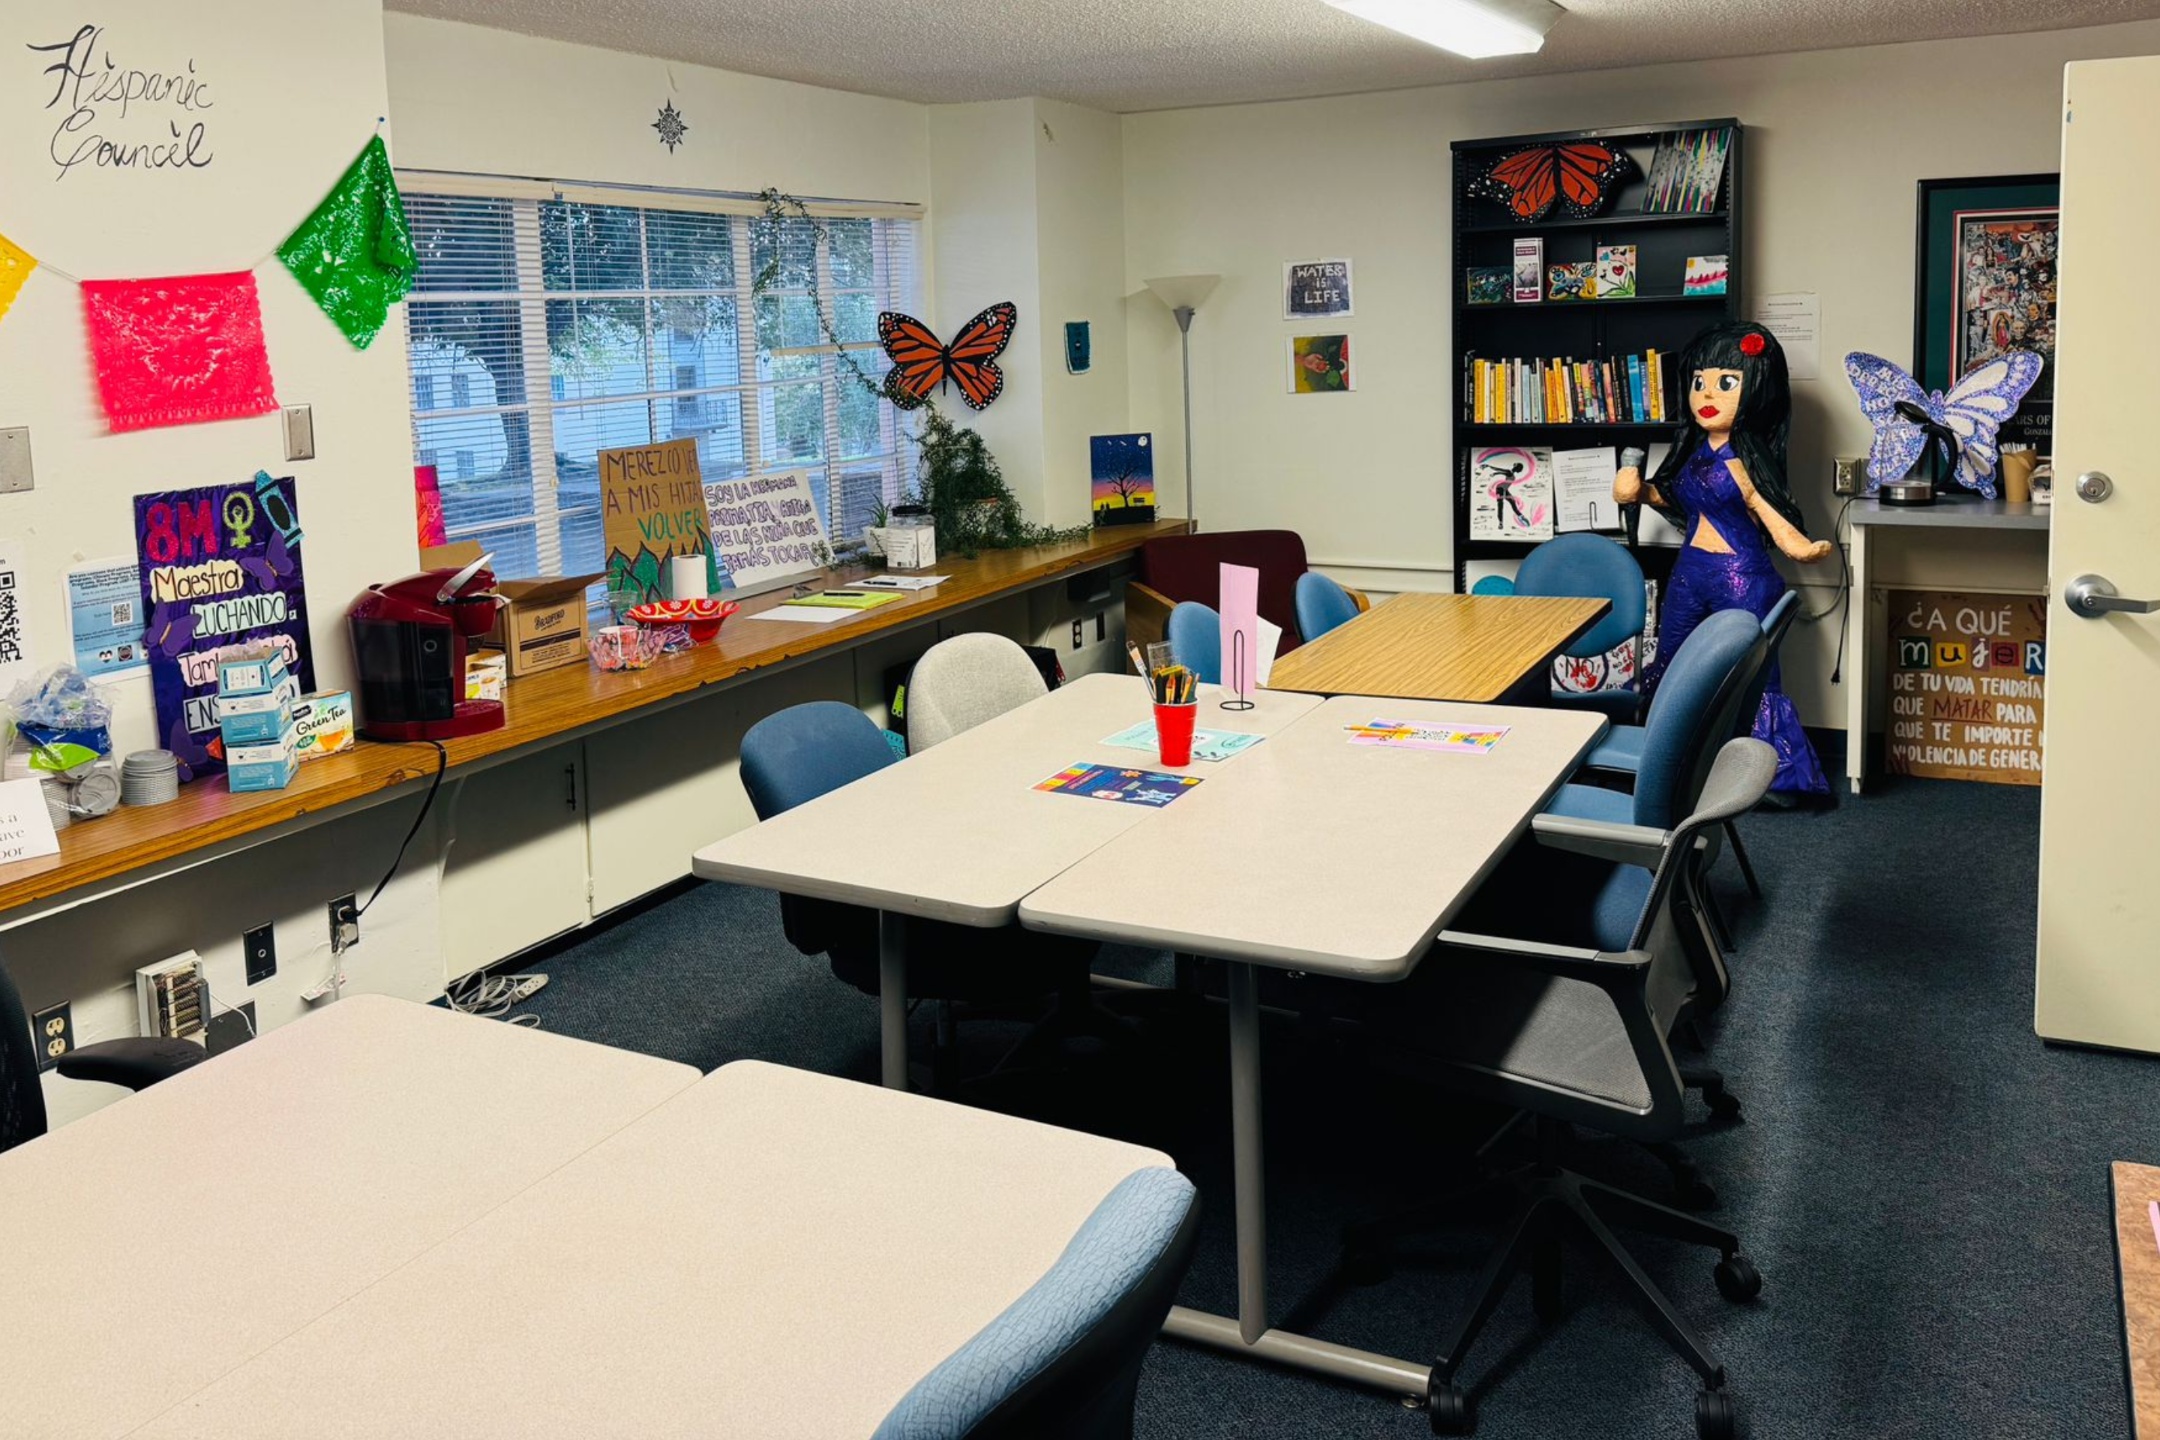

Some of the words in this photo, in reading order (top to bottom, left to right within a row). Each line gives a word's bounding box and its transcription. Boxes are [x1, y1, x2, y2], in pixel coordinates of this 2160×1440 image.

[26, 24, 214, 118] Hispanic
[50, 105, 214, 182] Council
[1295, 264, 1343, 278] WATER
[1304, 289, 1340, 304] LIFE
[2036, 414, 2052, 426] OF
[606, 446, 681, 483] MEREZCO
[607, 488, 622, 518] A
[627, 482, 660, 514] MIS
[704, 484, 735, 507] SOY
[734, 482, 751, 501] LA
[146, 498, 219, 563] 8M
[637, 508, 705, 541] VOLVER
[712, 529, 734, 547] DE
[733, 526, 763, 546] LAS
[792, 517, 819, 538] QUE
[153, 562, 240, 602] Maestra
[1956, 604, 2012, 636] QUÉ
[1893, 672, 1915, 691] DE
[1920, 672, 1942, 692] TU
[1945, 675, 1975, 695] VIDA
[1980, 675, 2045, 699] TENDRÍA
[296, 716, 331, 736] Green
[327, 705, 347, 721] Tea
[1893, 696, 1924, 716] QUE
[1932, 695, 1993, 720] MATAR
[1996, 702, 2037, 724] PARA
[1894, 721, 1924, 740] QUE
[1932, 722, 1951, 742] TE
[1964, 725, 2033, 747] IMPORTE
[1969, 748, 1987, 766] DE
